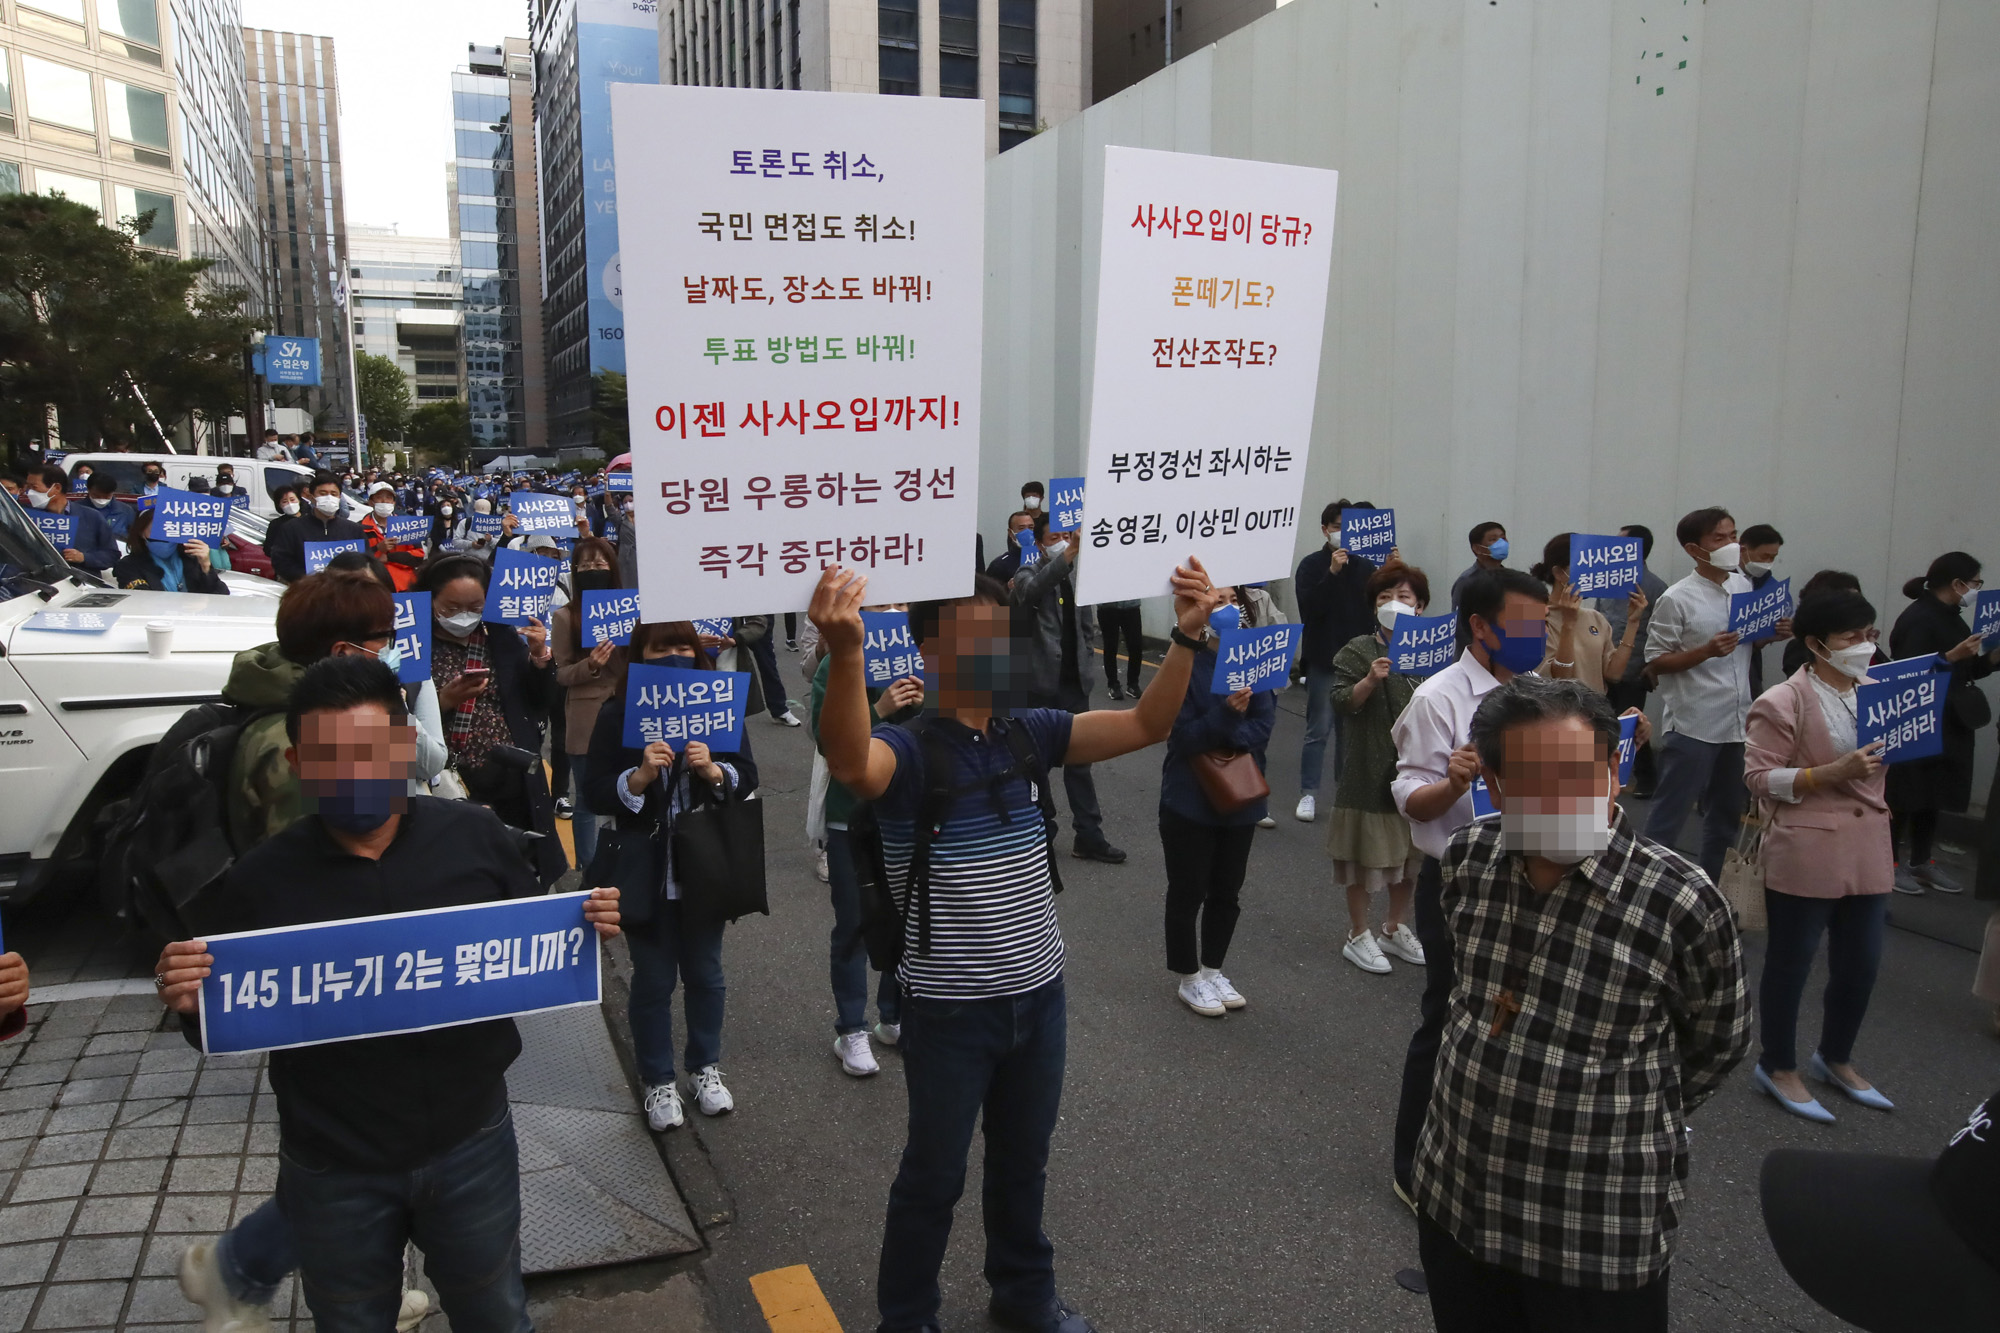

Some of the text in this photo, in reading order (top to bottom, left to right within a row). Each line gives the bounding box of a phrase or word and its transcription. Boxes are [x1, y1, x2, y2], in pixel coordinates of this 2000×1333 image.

[729, 149, 884, 183] 토론도 취소,
[698, 212, 916, 243] 국민 면접도 취소!
[1131, 204, 1312, 247] 사사오입이 당규?
[683, 275, 932, 305] 날짜도, 장소도 바꿔!
[1171, 276, 1275, 310] 폰떼기도?
[272, 359, 310, 370] 수협은행
[279, 341, 302, 358] Sh
[703, 334, 915, 366] 투표 방법도 바꿔!
[1152, 338, 1277, 369] 전산조작도?
[655, 394, 960, 440] 이젠 사사오입까지!
[1107, 445, 1292, 483] 부정경선 좌시하는
[661, 466, 955, 515] 당원 우롱하는 경선
[162, 501, 225, 518] 사사오입
[517, 500, 570, 514] 사사오입
[521, 515, 575, 531] 철회하라
[1347, 511, 1392, 533] 사사오입
[163, 521, 223, 538] 철회하라
[390, 518, 429, 533] 사사오입
[1090, 506, 1295, 549] 송영길, 이상민 OUT!!
[1349, 530, 1394, 551] 철회하라
[698, 533, 925, 579] 즉각 중단하라!
[1577, 542, 1639, 567] 사사오입
[499, 565, 558, 590] 사사오입
[1578, 566, 1639, 592] 철회하라
[1735, 583, 1786, 622] 사사오입
[592, 617, 639, 643] 철회하
[864, 625, 915, 652] 사사
[1397, 614, 1458, 648] 사사오입
[1225, 629, 1290, 665] 사사오입
[1397, 638, 1456, 670] 철회하라
[1226, 653, 1287, 691] 철회하라
[636, 677, 734, 710] 사사오입
[1866, 679, 1936, 728] 사사오입
[640, 708, 736, 743] 철회하라
[220, 927, 585, 1013] 145 나누기 2는 몇입니까?
